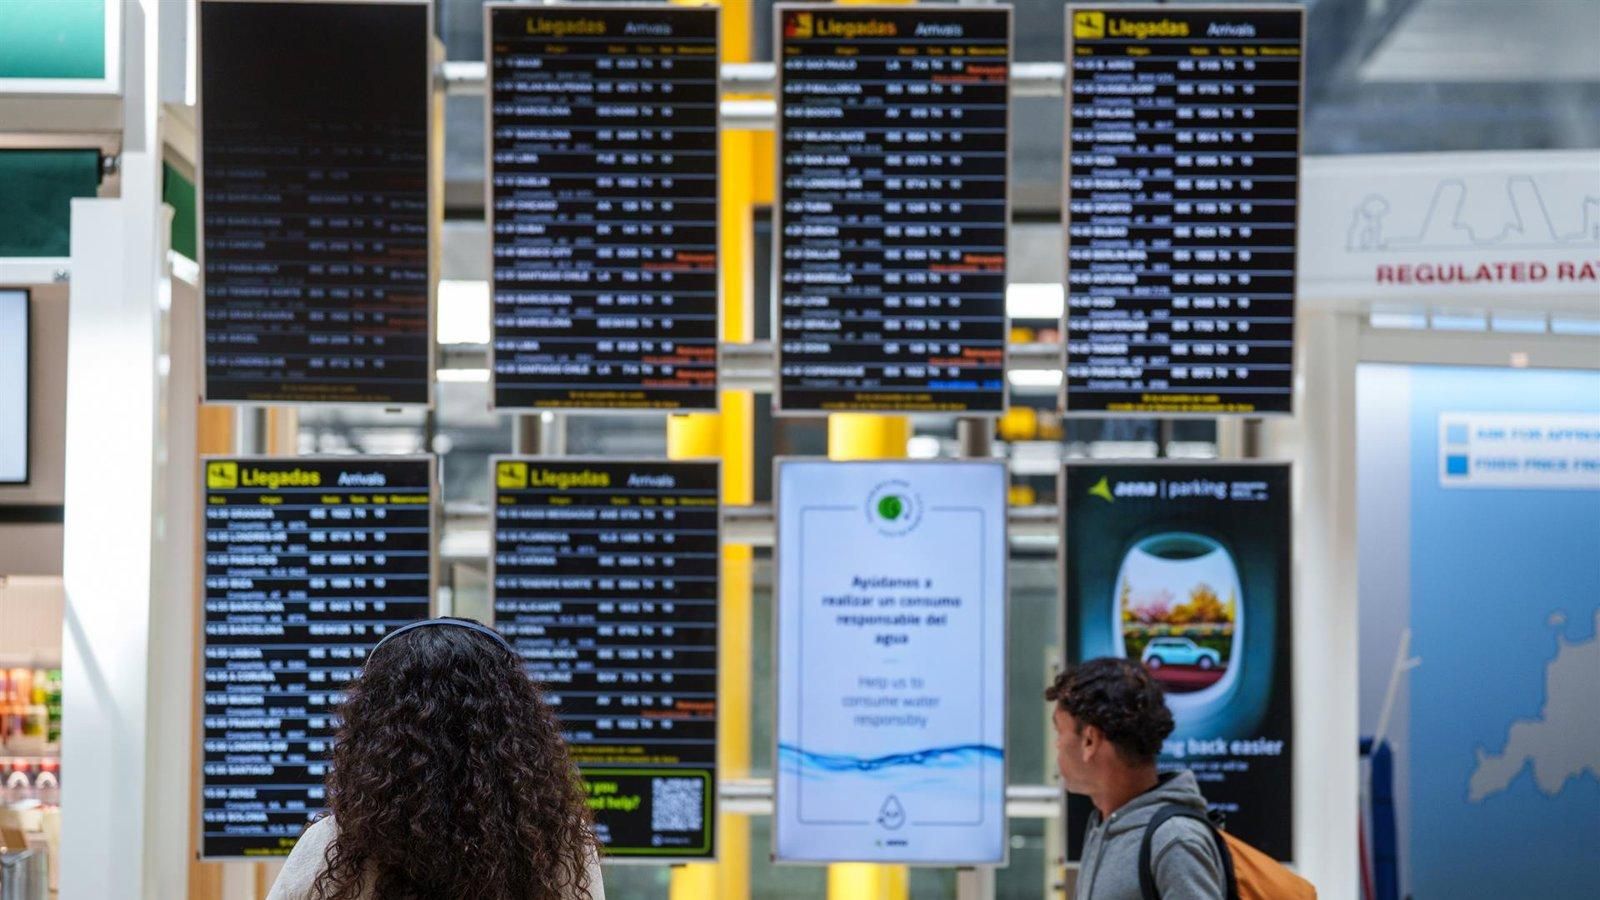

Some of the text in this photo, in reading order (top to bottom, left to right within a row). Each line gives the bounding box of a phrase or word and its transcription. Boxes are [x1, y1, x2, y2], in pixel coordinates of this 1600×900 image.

[526, 18, 605, 36] Llegadas
[818, 18, 896, 37] Llegadas
[1108, 19, 1256, 38] Llegadas Arrivals
[1376, 261, 1600, 284] REGULATED RA
[242, 470, 386, 489] Llegadas Arrivals
[532, 470, 675, 489] Llegadas Arrivals
[1114, 482, 1157, 497] aena
[1169, 480, 1227, 499] parking
[852, 576, 932, 590] Ayúdanos a
[230, 601, 284, 612] BARCELONA
[822, 595, 962, 606] realizar un consumo
[836, 614, 947, 626] responsable del
[230, 624, 284, 634] BARCELONA
[875, 634, 908, 646] agua
[858, 676, 924, 690] Help us to
[842, 696, 940, 707] consume water
[854, 714, 928, 728] responsibly
[1188, 738, 1227, 755] back
[1230, 738, 1284, 756] easier
[594, 782, 618, 794] you
[607, 796, 640, 811] help?
